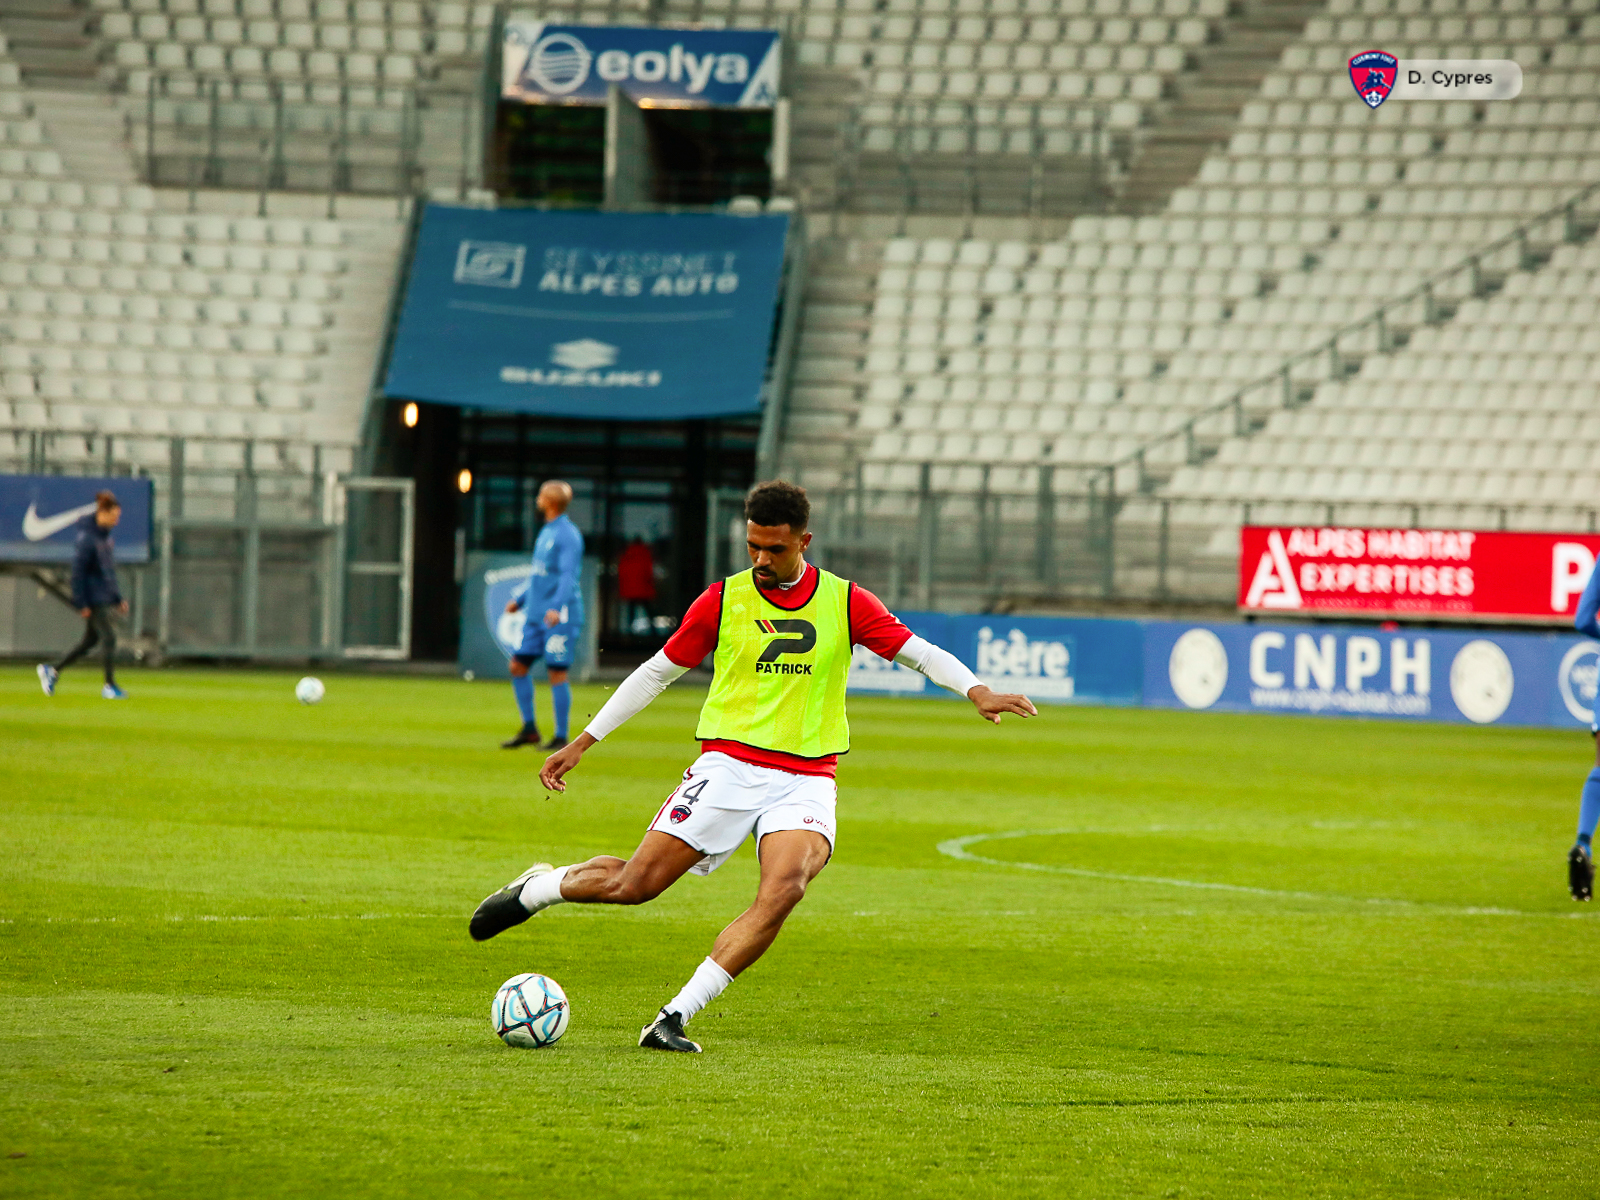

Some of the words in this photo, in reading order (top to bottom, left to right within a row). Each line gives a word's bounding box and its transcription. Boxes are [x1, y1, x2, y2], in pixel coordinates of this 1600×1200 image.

[596, 42, 749, 94] eolya
[538, 271, 643, 297] ALPES
[651, 271, 739, 297] AUTO
[1287, 528, 1366, 558] ALPES
[1368, 529, 1476, 561] HABITAT
[1299, 562, 1475, 597] EXPERTISES
[977, 626, 1071, 676] isère
[1250, 631, 1431, 695] CNPH
[755, 662, 813, 675] PATRICK
[681, 779, 710, 806] 4
